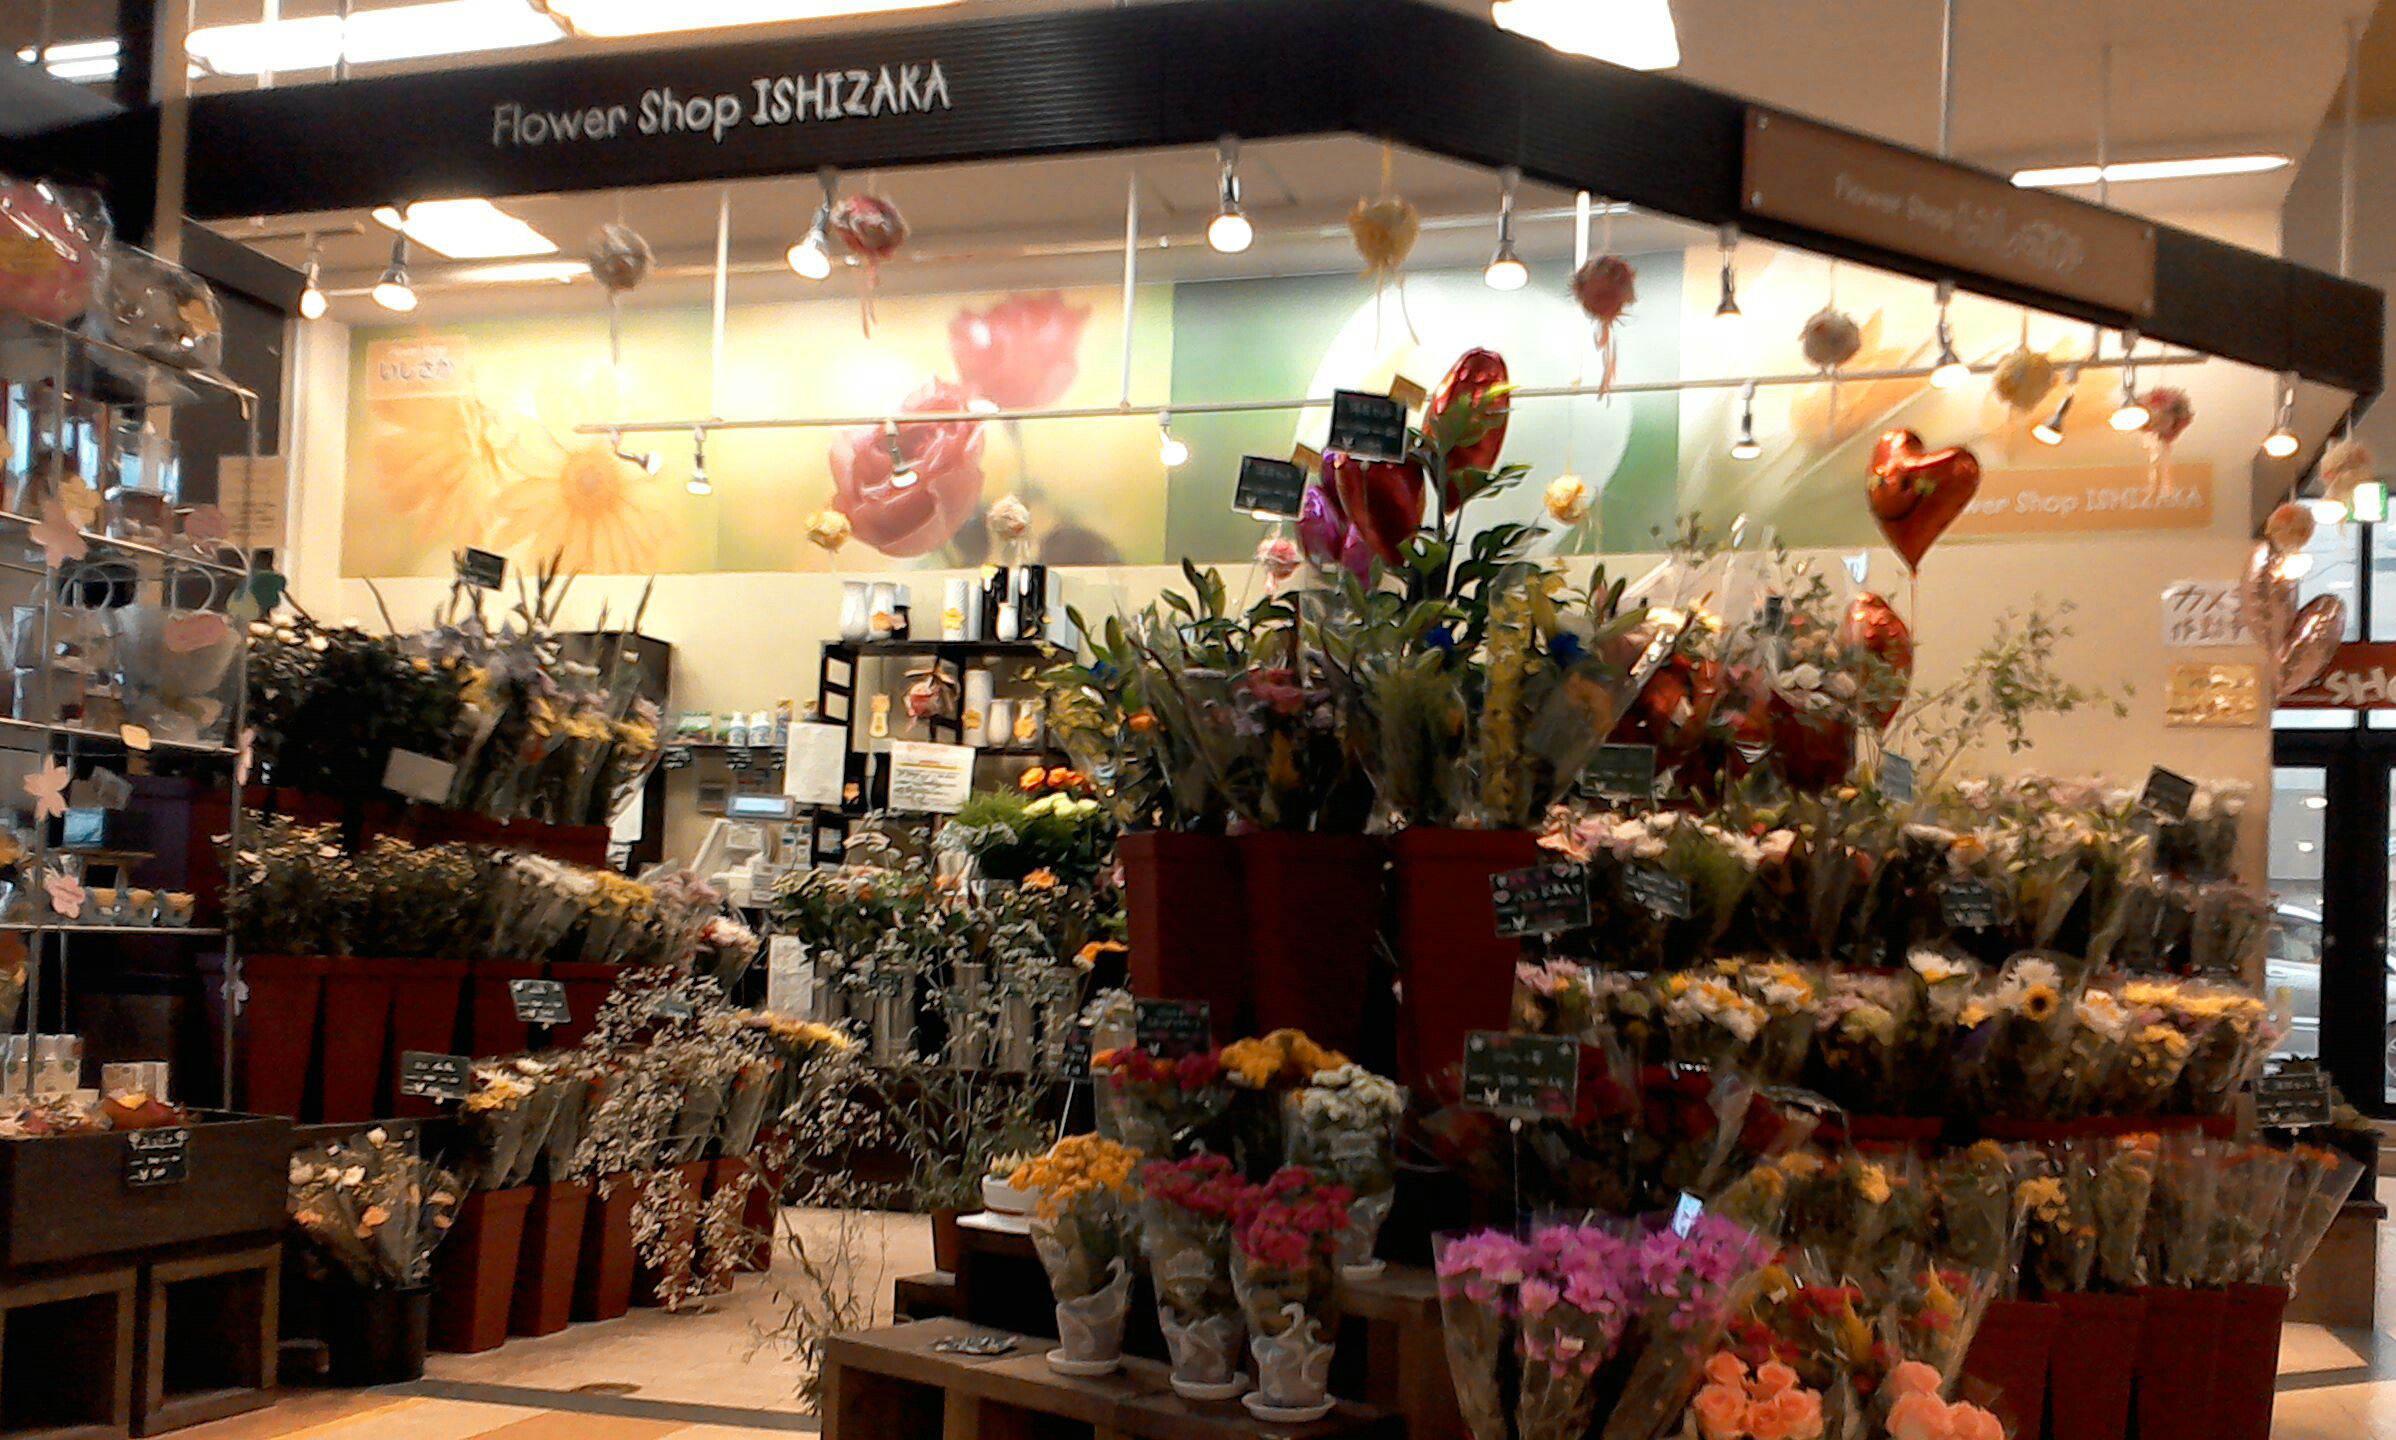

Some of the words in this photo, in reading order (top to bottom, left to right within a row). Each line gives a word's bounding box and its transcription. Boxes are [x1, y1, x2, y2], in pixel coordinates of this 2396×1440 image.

[492, 101, 628, 147] Flower
[637, 86, 742, 144] Shop
[750, 58, 953, 128] ISHIZAKA
